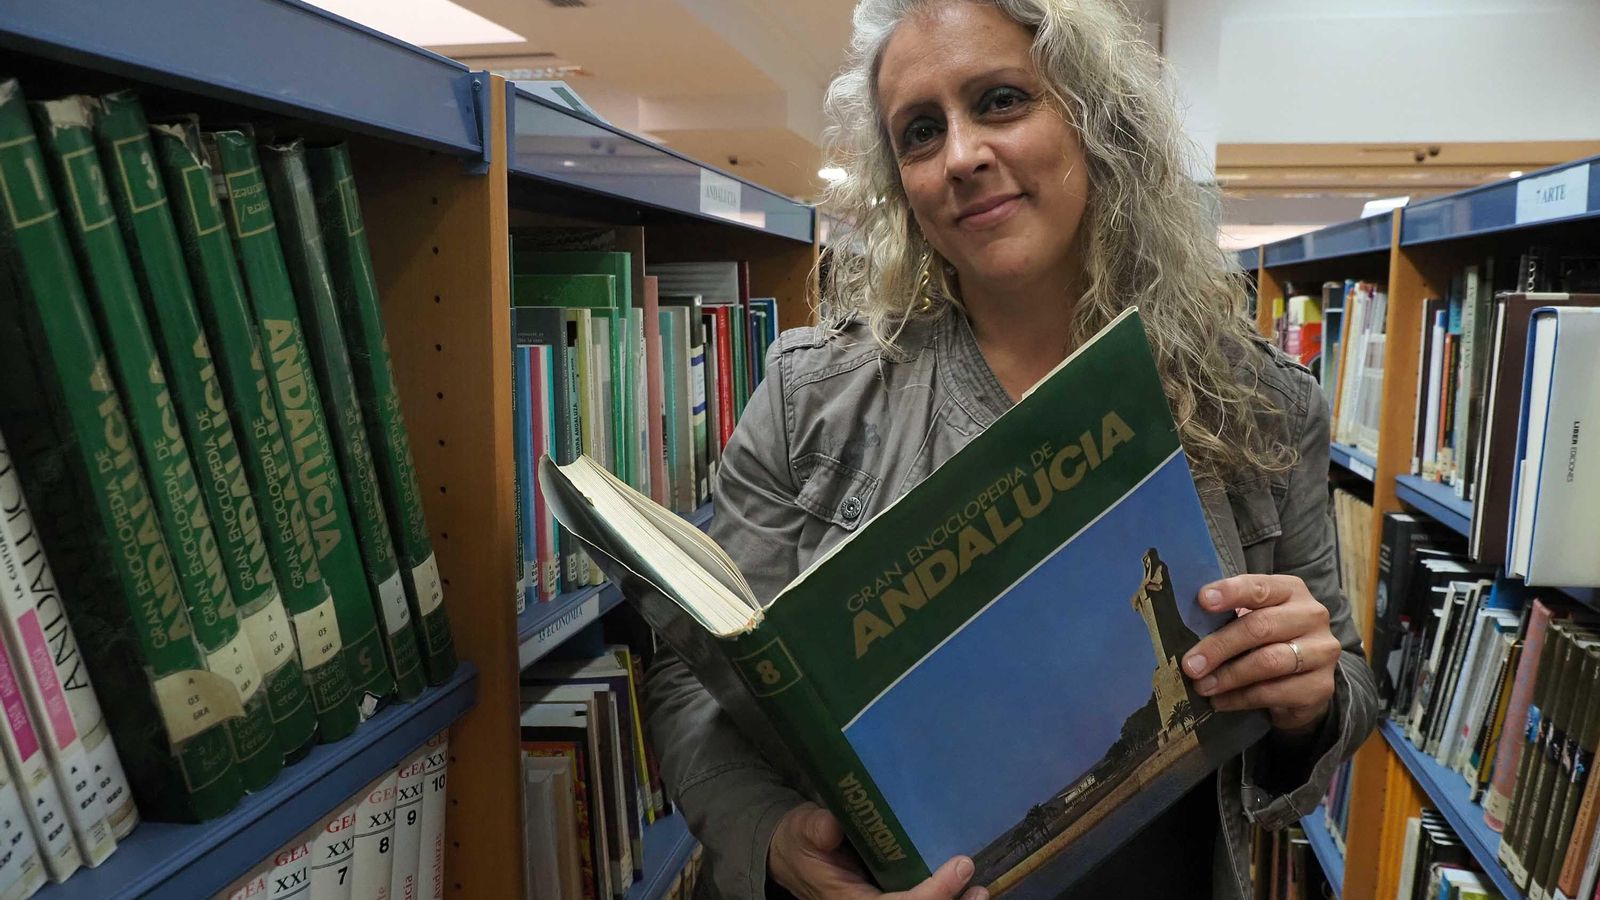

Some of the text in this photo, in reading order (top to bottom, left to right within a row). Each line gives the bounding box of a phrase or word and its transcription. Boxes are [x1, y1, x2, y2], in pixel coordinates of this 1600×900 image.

[141, 151, 158, 190] 3
[1544, 184, 1566, 204] ARTE
[263, 318, 341, 561] ANDALUCIA
[1567, 420, 1580, 483] LIBER EDICIONES
[196, 408, 257, 592] GRAN ENCICLOPEDIA DE
[253, 414, 306, 590] GRAN ENCICLOPEDIA DE
[154, 436, 219, 628] GRAN ENCICLOPEDIA DE
[846, 440, 1054, 613] GRAN ENCICLOPEDIA DE
[851, 409, 1137, 660] ANDALUCIA
[95, 451, 168, 649] GRAN ENCICLOPEDIA DE
[321, 642, 333, 654] GRA
[357, 647, 373, 675] 5
[755, 660, 781, 685] 8
[399, 761, 425, 779] GEA
[368, 786, 398, 805] GEA
[399, 782, 424, 801] XXI
[431, 774, 446, 793] 10
[326, 813, 356, 834] GEA
[370, 807, 397, 829] XXI
[407, 809, 417, 826] 9
[838, 771, 908, 861] ANDALUCIA
[274, 842, 309, 867] GEA
[327, 836, 355, 859] XXI
[379, 837, 390, 854] 8
[275, 867, 308, 895] XXI
[337, 866, 349, 886] 7
